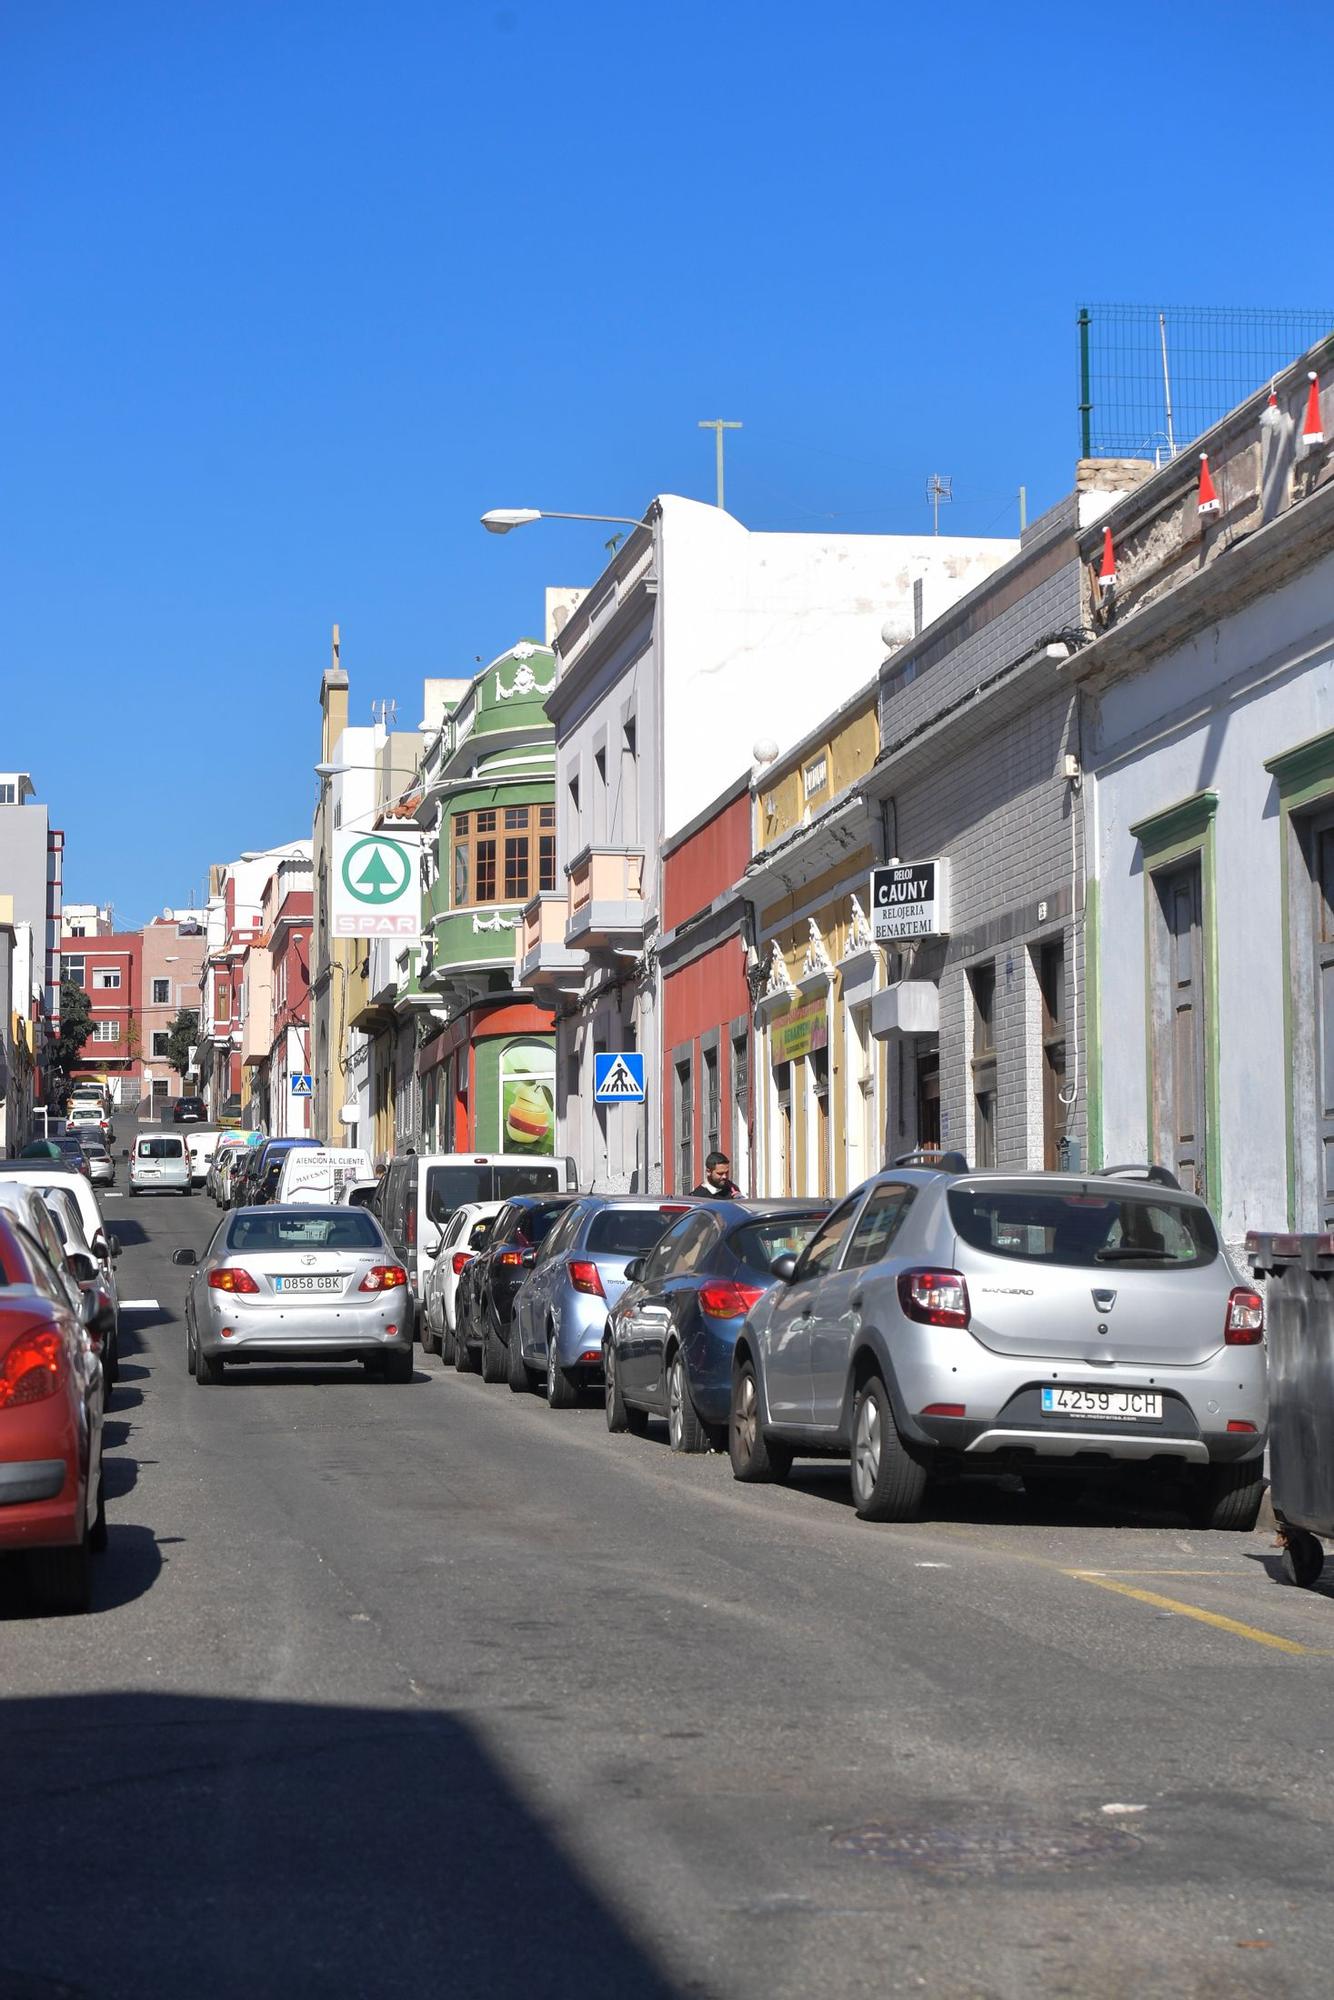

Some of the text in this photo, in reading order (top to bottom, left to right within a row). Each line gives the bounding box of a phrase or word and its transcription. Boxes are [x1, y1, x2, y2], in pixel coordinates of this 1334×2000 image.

[894, 869, 912, 881] RELOJ
[878, 880, 928, 904] CAUNY
[882, 905, 924, 919] RELOJERIA
[337, 916, 415, 932] SPAR
[876, 920, 932, 938] BENARTEMI
[284, 1277, 340, 1288] 0858 GBK
[1057, 1390, 1156, 1413] 4259 JCH
